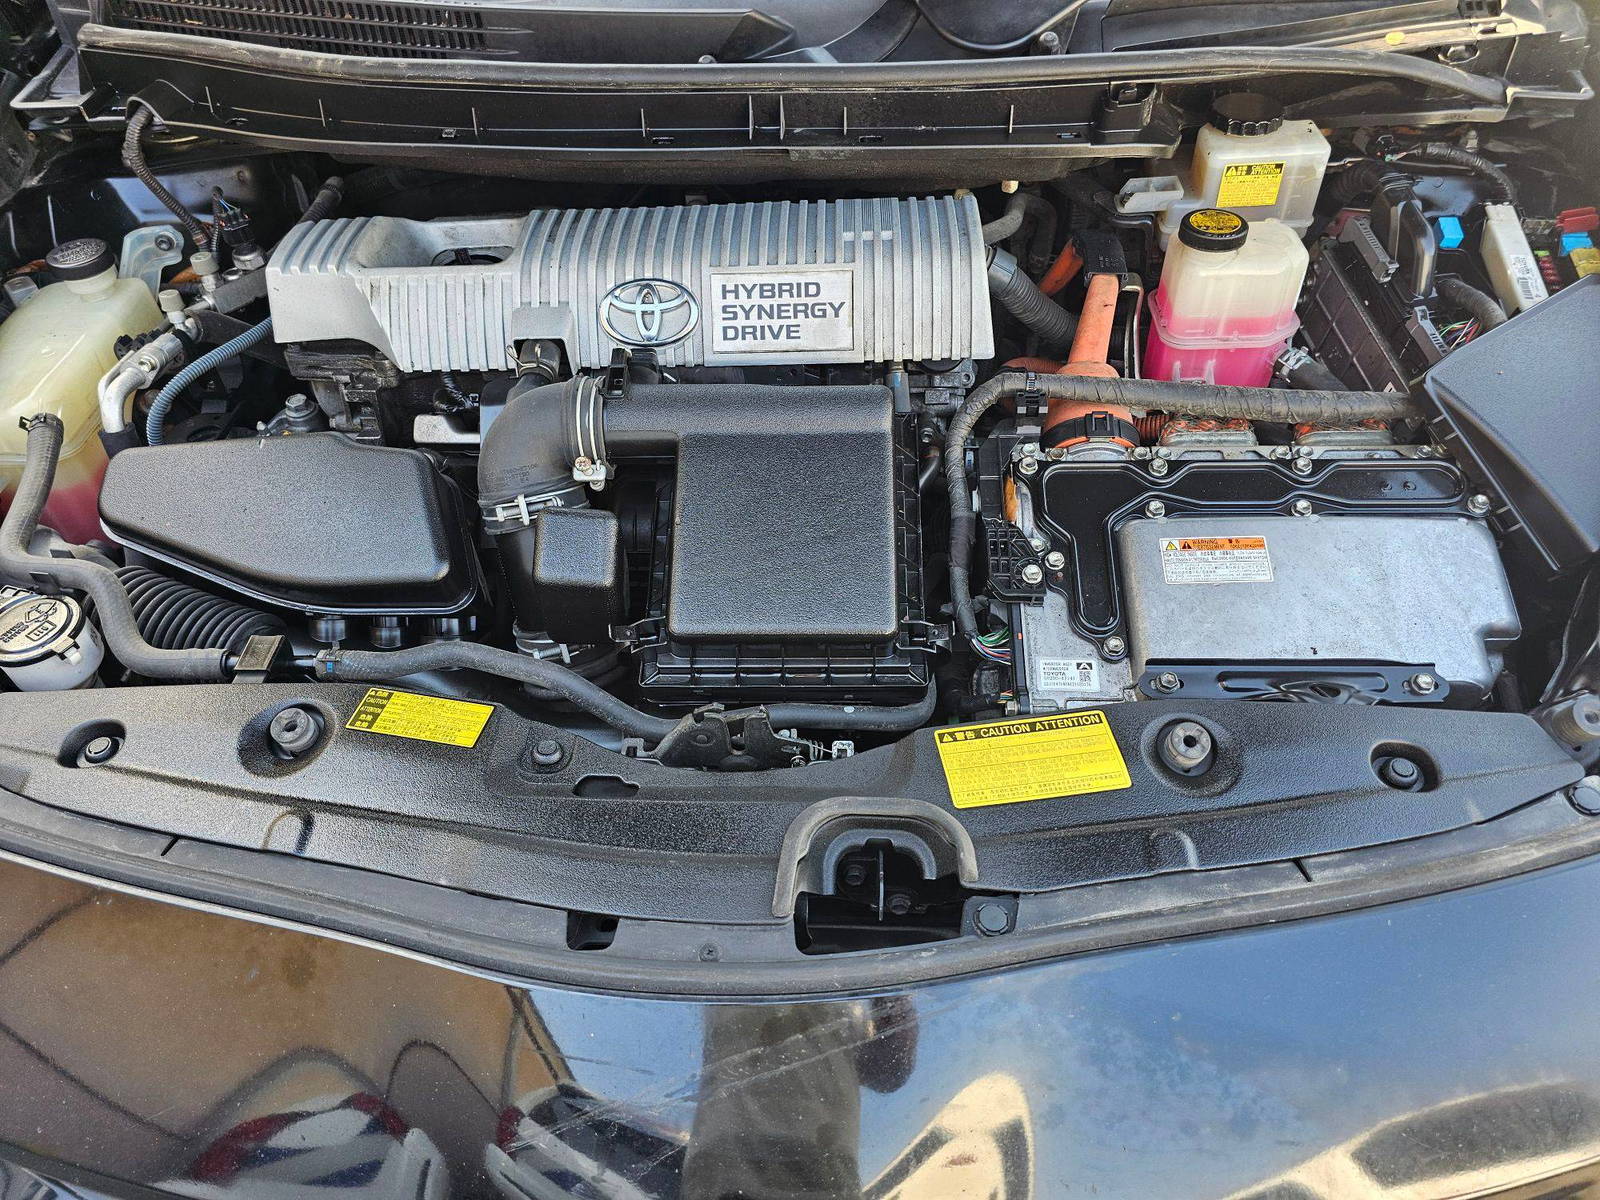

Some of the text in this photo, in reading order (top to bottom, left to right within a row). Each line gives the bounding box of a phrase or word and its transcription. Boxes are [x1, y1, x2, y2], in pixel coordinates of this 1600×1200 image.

[721, 282, 821, 300] HYBRID
[721, 301, 846, 321] SYNERGY
[722, 324, 801, 341] DRIVE
[366, 697, 388, 705] CAUTION
[980, 723, 1031, 738] CAUTION
[1035, 715, 1100, 731] ATTENTION
